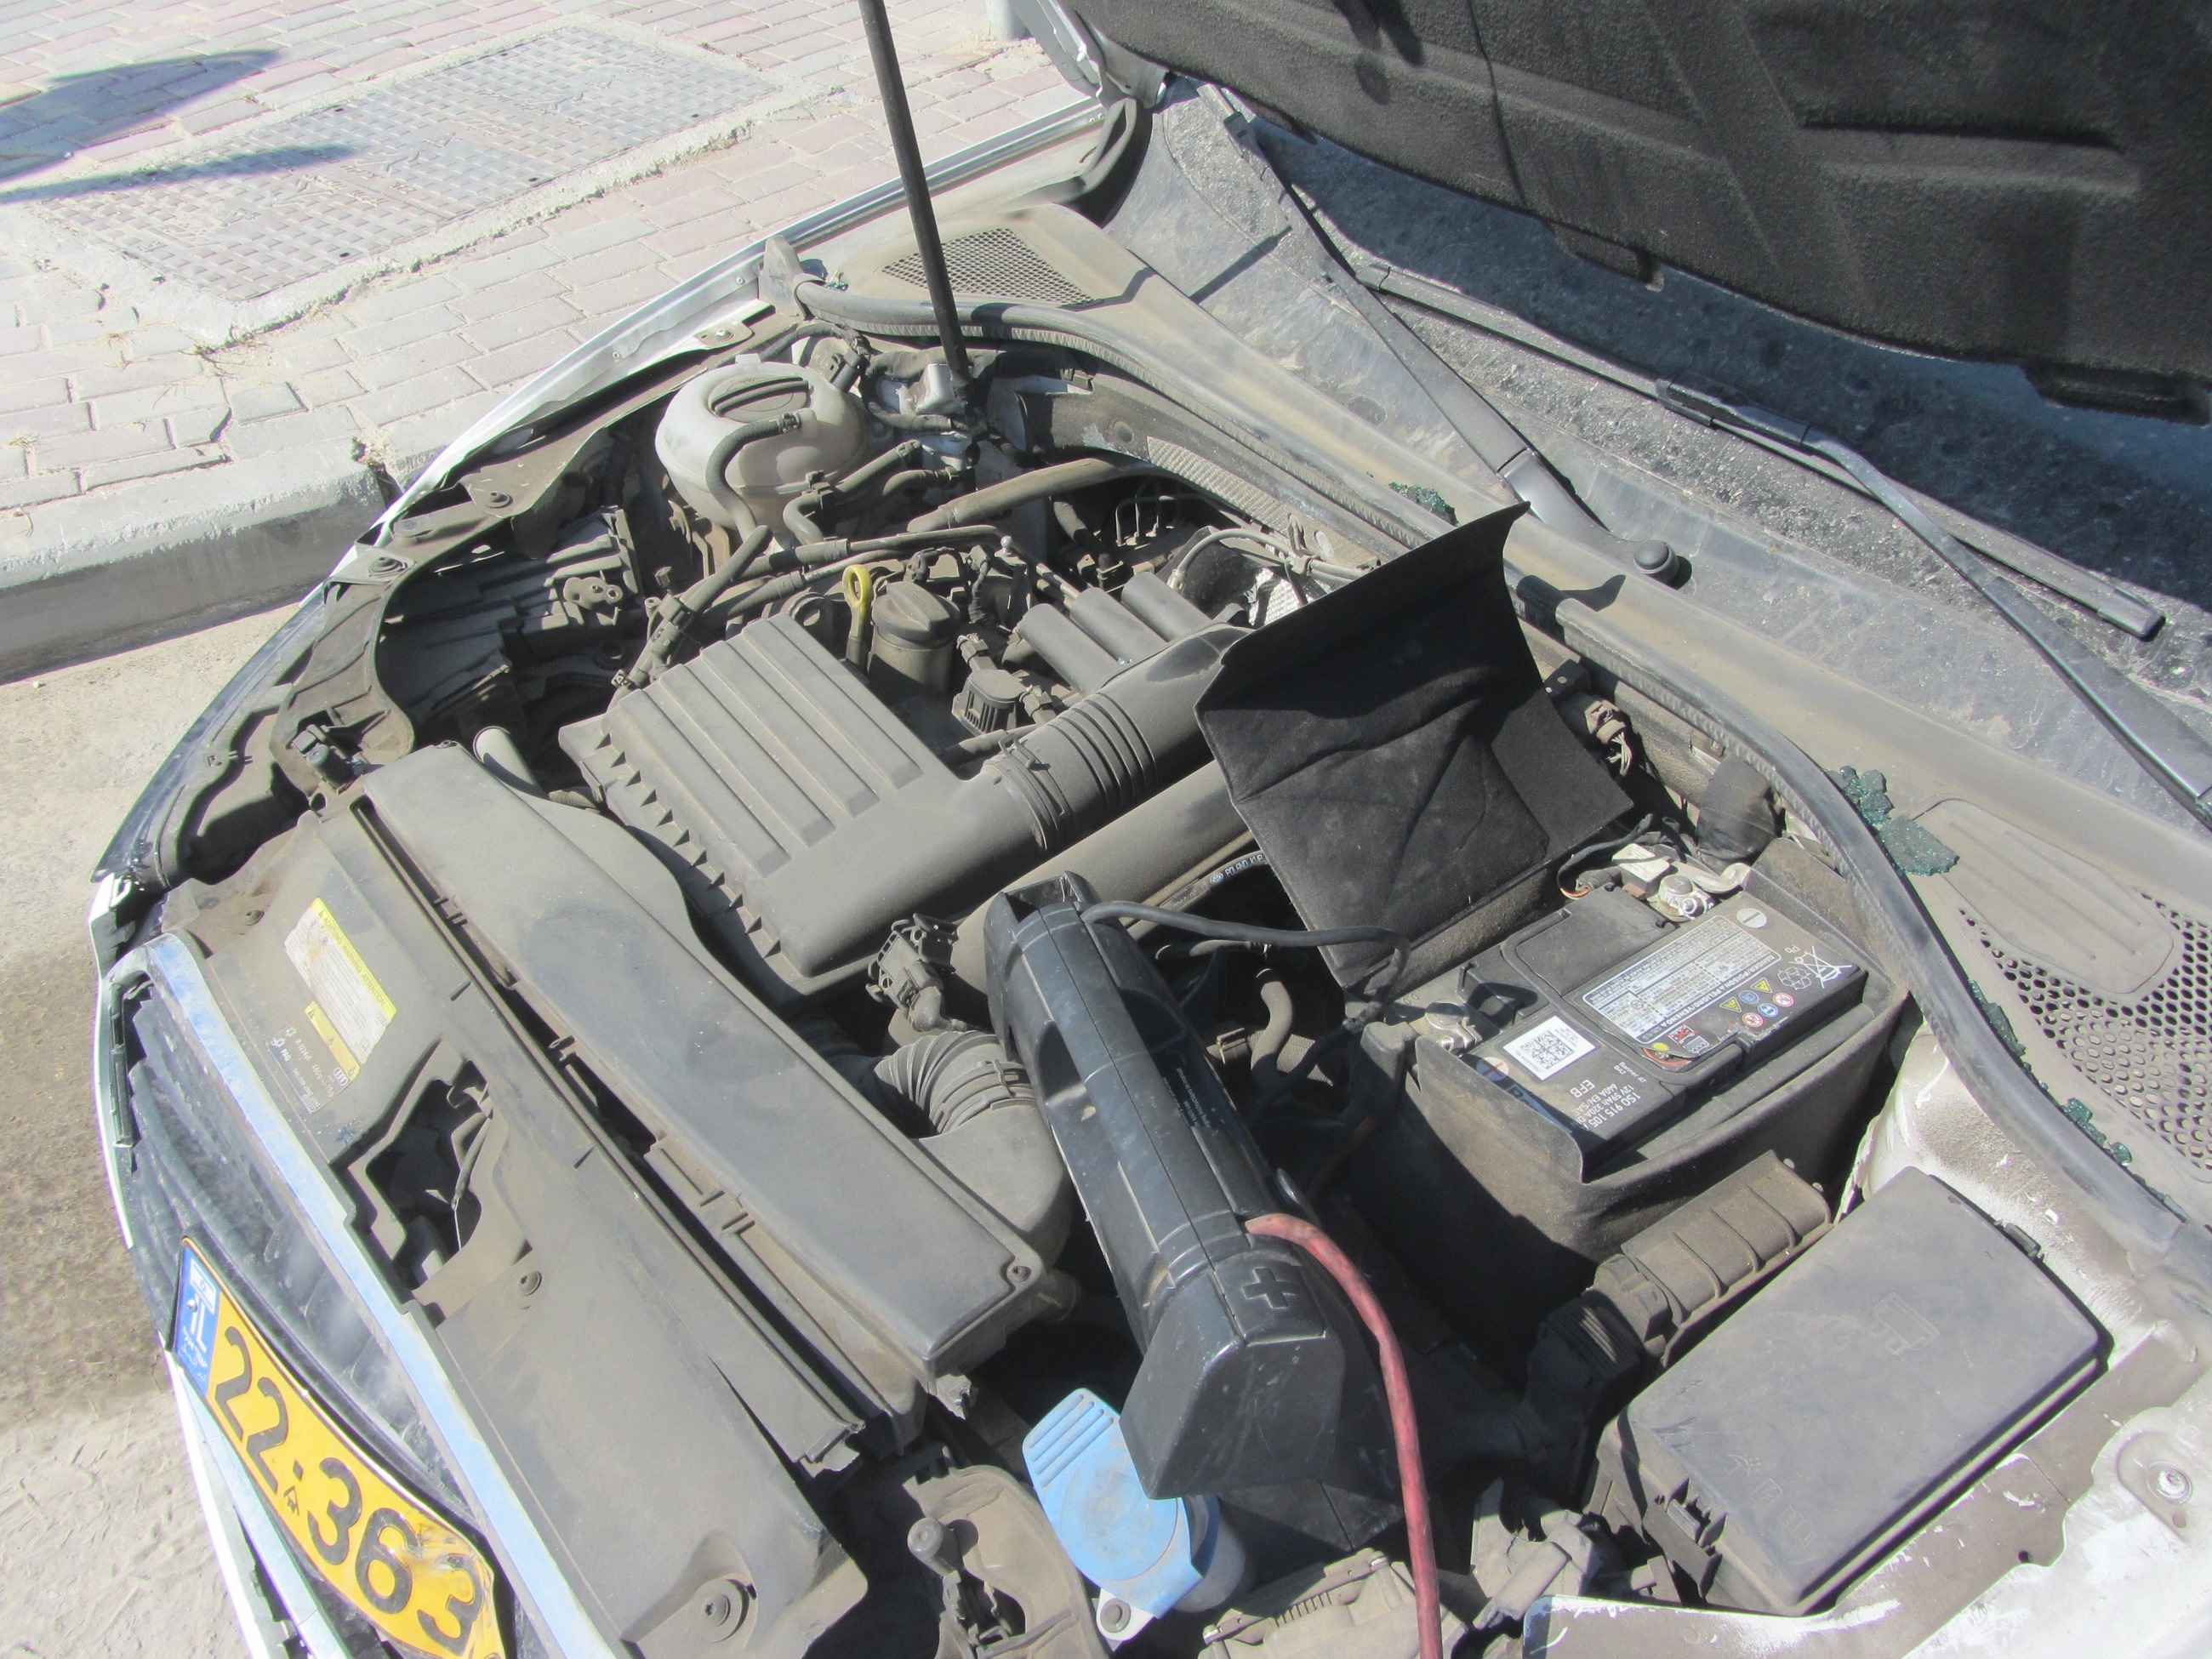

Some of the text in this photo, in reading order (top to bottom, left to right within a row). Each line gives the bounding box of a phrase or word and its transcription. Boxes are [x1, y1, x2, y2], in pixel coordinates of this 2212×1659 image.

[323, 918, 342, 944] ACHTUNG
[342, 944, 362, 973] WARNING
[362, 973, 385, 1006] ATTENTION
[280, 1048, 292, 1062] PAG
[1619, 1061, 1639, 1078] Banner
[1570, 1080, 1595, 1097] EFB
[1620, 1084, 1634, 1096] 12V
[1571, 1083, 1617, 1116] 640A EN/SAE
[1601, 1092, 1622, 1105] 59Ah
[1585, 1103, 1604, 1118] 320A
[1605, 1103, 1623, 1117] 915
[1588, 1114, 1607, 1127] 105
